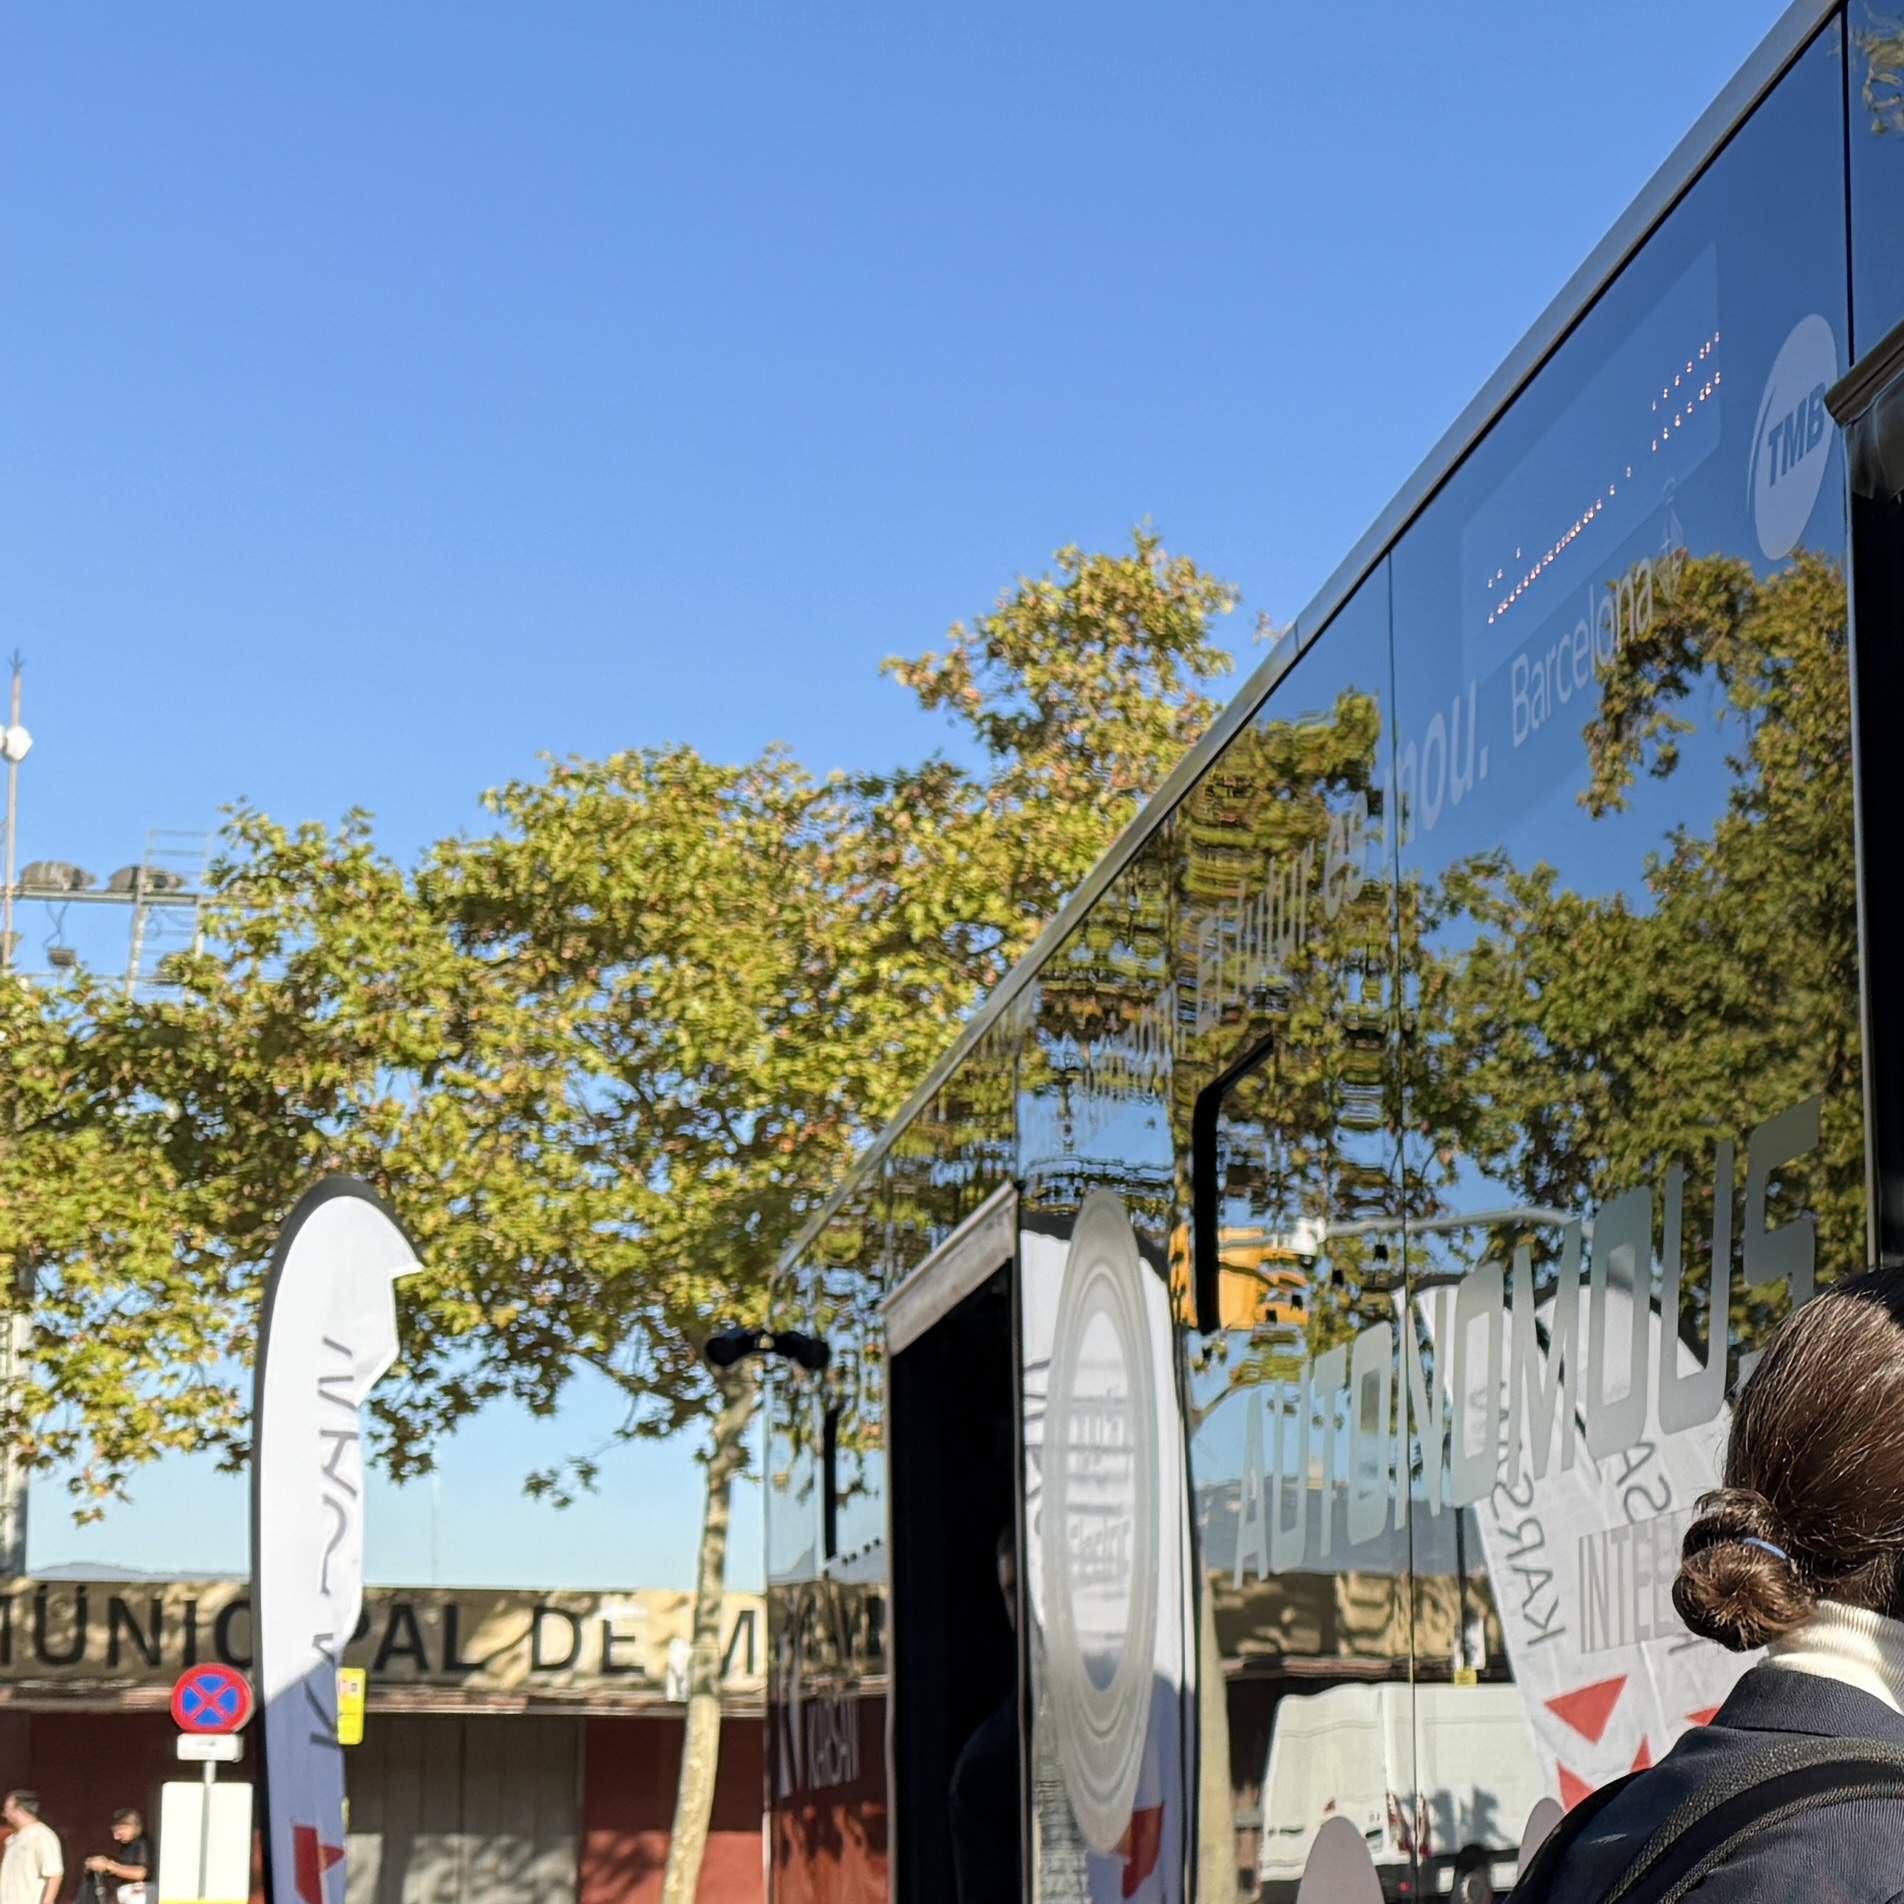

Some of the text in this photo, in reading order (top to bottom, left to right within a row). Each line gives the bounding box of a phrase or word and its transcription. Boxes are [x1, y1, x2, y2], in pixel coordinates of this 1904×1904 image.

[1768, 382, 1825, 488] TMB
[1511, 557, 1653, 749] Barcelona
[1232, 1103, 1822, 1591] AUTONOMOUS
[530, 1605, 645, 1675] DE
